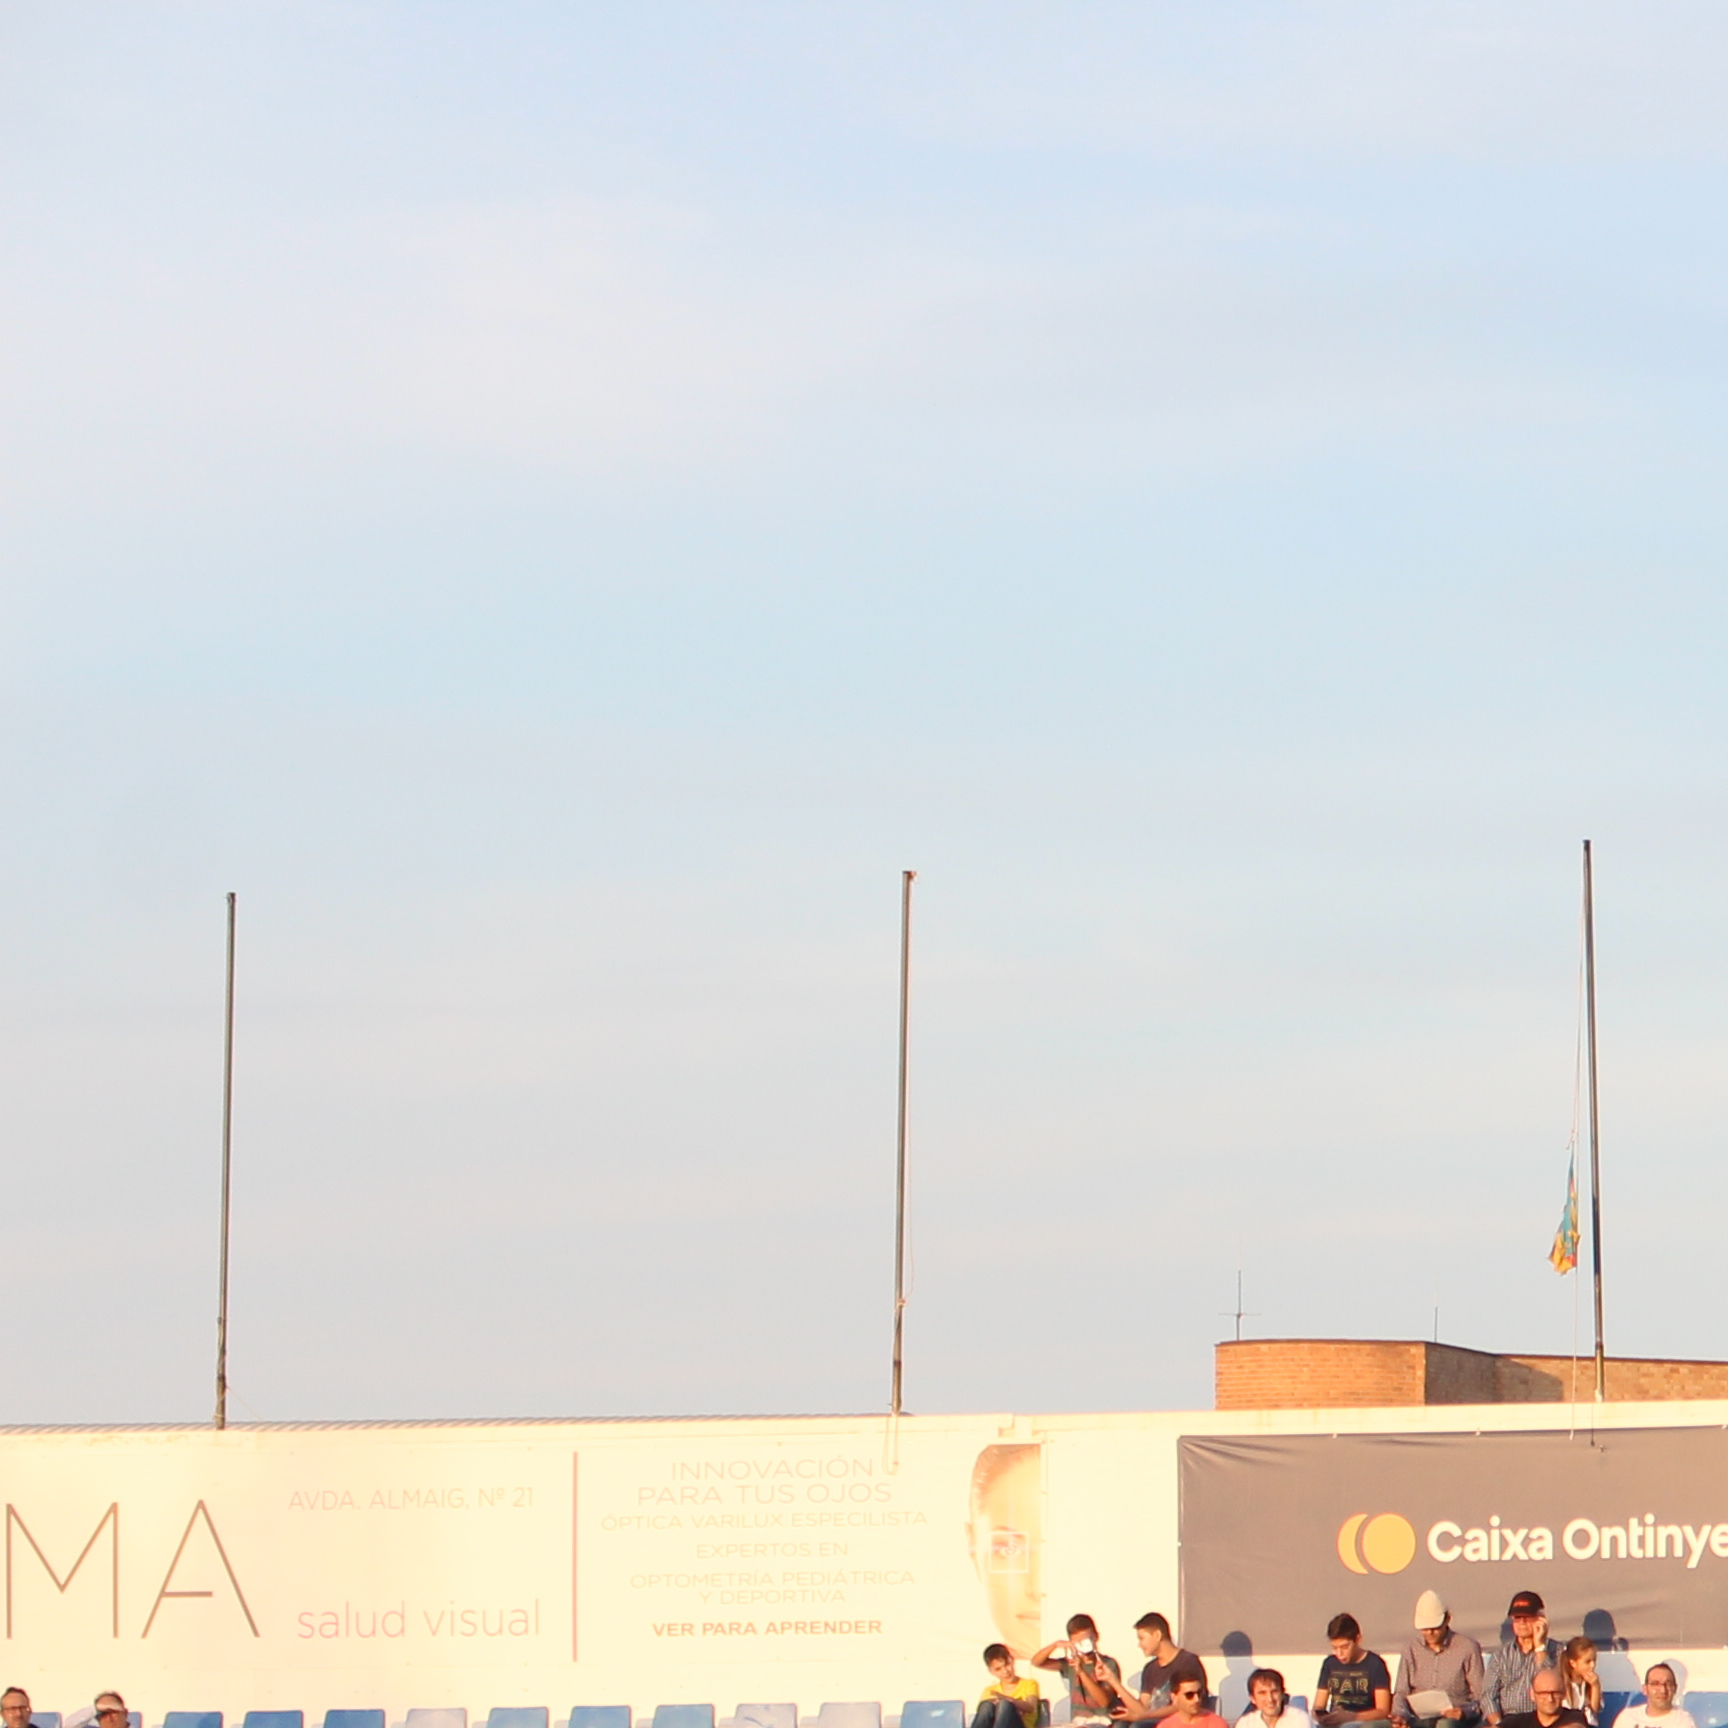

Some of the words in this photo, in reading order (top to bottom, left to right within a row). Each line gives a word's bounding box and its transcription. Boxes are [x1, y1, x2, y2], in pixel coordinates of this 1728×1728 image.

[671, 1455, 875, 1481] INNOVACIÓN
[288, 1489, 361, 1512] AVDA.
[368, 1487, 470, 1512] ALMAIG,
[512, 1486, 534, 1508] 21
[637, 1485, 724, 1506] PARA
[734, 1484, 795, 1505] TUS
[806, 1482, 893, 1505] OJOS
[600, 1514, 684, 1532] ÓPTICA
[689, 1513, 783, 1530] VARILUX
[790, 1510, 929, 1528] ESPECILISTA
[695, 1543, 812, 1559] EXPERTOS
[818, 1542, 849, 1557] EN
[1427, 1515, 1553, 1563] Caixa
[630, 1569, 774, 1590] OPTOMETRÍA
[781, 1567, 916, 1587] PEDIÁTRICA
[698, 1591, 713, 1605] Y
[720, 1589, 847, 1605] DEPORTIVA
[297, 1601, 406, 1640] salud
[422, 1598, 541, 1638] visual
[652, 1621, 695, 1638] VER
[701, 1621, 758, 1637] PARA
[764, 1619, 883, 1636] APRENDER
